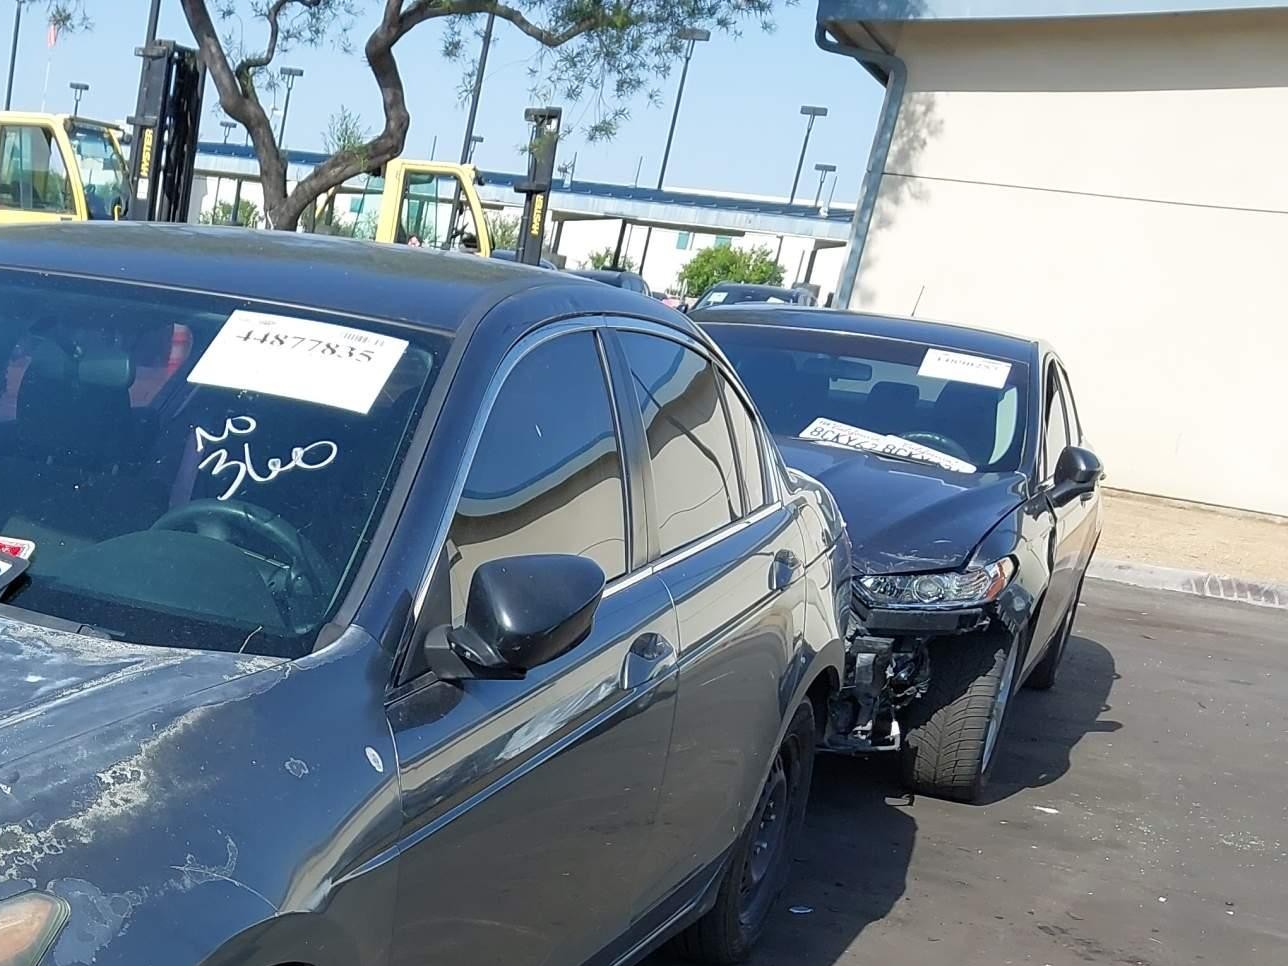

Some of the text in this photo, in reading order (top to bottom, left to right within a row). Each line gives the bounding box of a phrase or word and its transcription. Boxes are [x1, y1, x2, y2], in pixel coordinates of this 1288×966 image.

[140, 128, 153, 177] HYSTER
[236, 329, 376, 363] 44877835
[197, 442, 338, 501] 360
